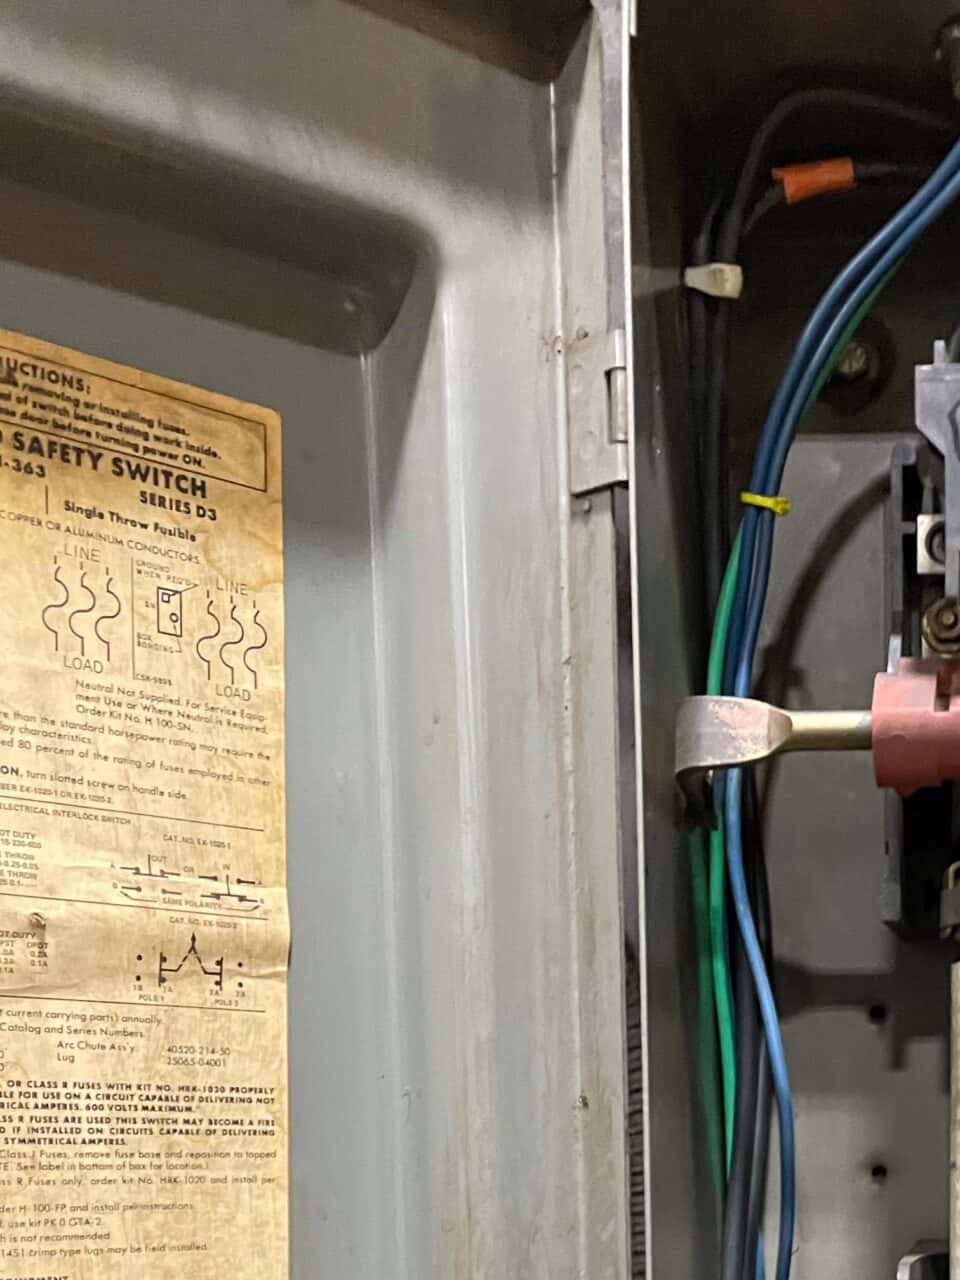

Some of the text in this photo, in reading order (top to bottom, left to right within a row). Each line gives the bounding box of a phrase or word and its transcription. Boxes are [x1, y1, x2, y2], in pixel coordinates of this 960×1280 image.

[0, 356, 91, 395] UCTIONS:
[13, 430, 207, 499] SAFETY SWITCH
[139, 490, 217, 522] SERIES D3
[64, 499, 196, 542] Single Throw Fusible
[65, 525, 124, 547] ALUMINUM
[127, 539, 200, 565] CONDUCTORS
[64, 543, 100, 563] LINE
[216, 577, 248, 597] LINE
[63, 655, 104, 674] LOAD
[75, 679, 114, 693] Neutral
[205, 702, 237, 716] Service
[215, 684, 252, 702] LOAD
[104, 696, 123, 708] Use
[75, 704, 106, 717] Order
[61, 720, 105, 734] standard
[108, 725, 164, 743] horsepower
[35, 744, 75, 757] percent
[45, 1011, 87, 1023] carrying
[121, 1014, 162, 1025] annually
[0, 1022, 41, 1035] Catalog
[44, 1025, 64, 1034] and
[66, 1026, 97, 1036] Series
[57, 1040, 76, 1049] Arc
[77, 1040, 107, 1051] Chute
[56, 1052, 76, 1063] Lug
[7, 1079, 22, 1088] OR
[26, 1080, 58, 1089] CLASS
[73, 1081, 102, 1090] FUSES
[106, 1082, 132, 1091] WITH
[229, 1086, 275, 1095] PROPERLY
[18, 1091, 38, 1099] FOR
[42, 1091, 60, 1100] USE
[64, 1092, 81, 1100] ON
[95, 1093, 135, 1101] CIRCUIT
[138, 1094, 180, 1103] CAPABLE
[183, 1095, 195, 1103] OF
[198, 1095, 253, 1105] DELIVERING
[256, 1097, 275, 1105] NOT
[85, 1103, 105, 1112] 600
[107, 1103, 138, 1112] VOLTS
[30, 1115, 59, 1124] FUSES
[63, 1116, 82, 1124] ARE
[86, 1116, 112, 1125] USED
[115, 1116, 137, 1125] THIS
[141, 1117, 179, 1126] SWITCH
[183, 1117, 204, 1126] MAY
[208, 1118, 244, 1127] BECOME
[12, 1126, 275, 1137] IF INSTALLED ON CIRCUITS CAPABLE OF DELIVERING
[4, 1137, 77, 1146] SYMMETRICAL
[40, 1231, 111, 1243] recommended
